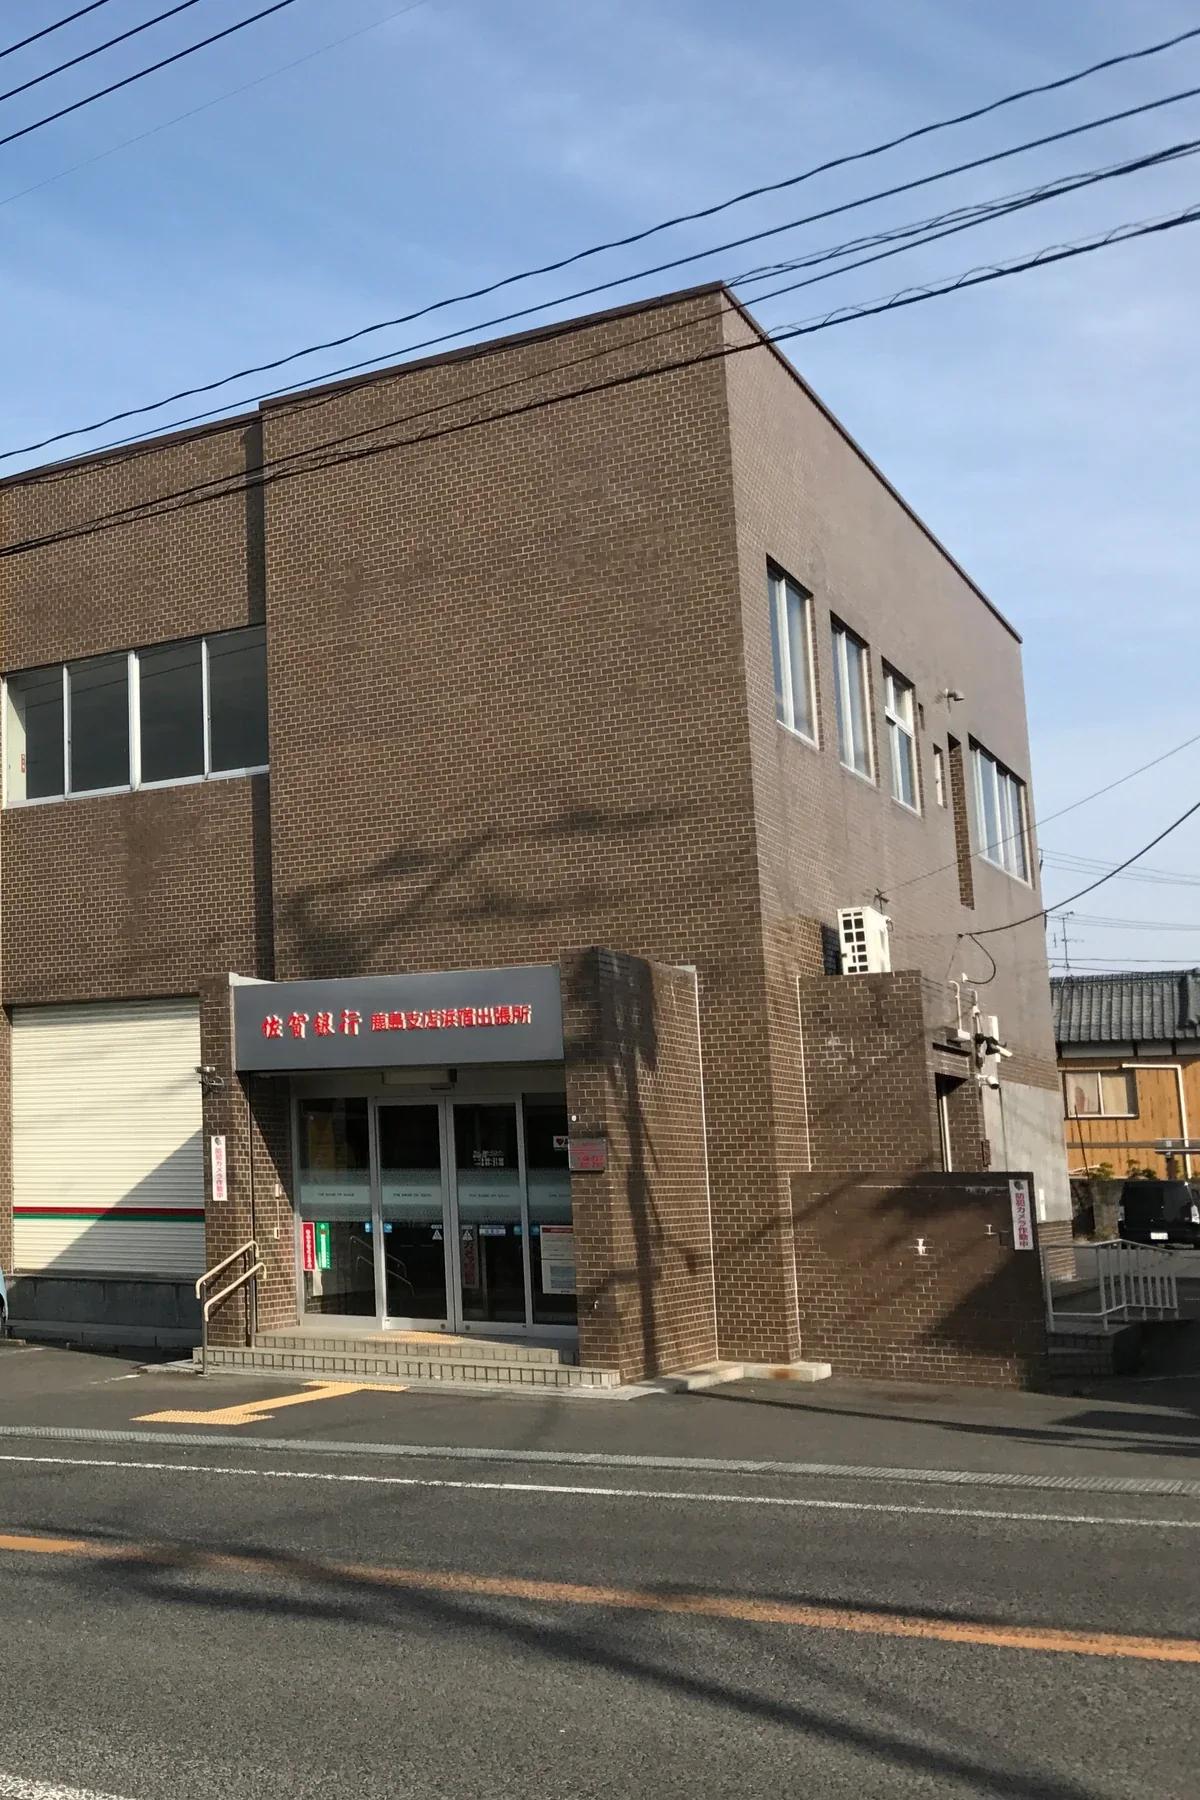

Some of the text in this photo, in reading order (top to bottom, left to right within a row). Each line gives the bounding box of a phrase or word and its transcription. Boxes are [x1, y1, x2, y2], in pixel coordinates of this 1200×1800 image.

[261, 1004, 532, 1038] 佐賀銀行 鹿島支店浜宿出張所
